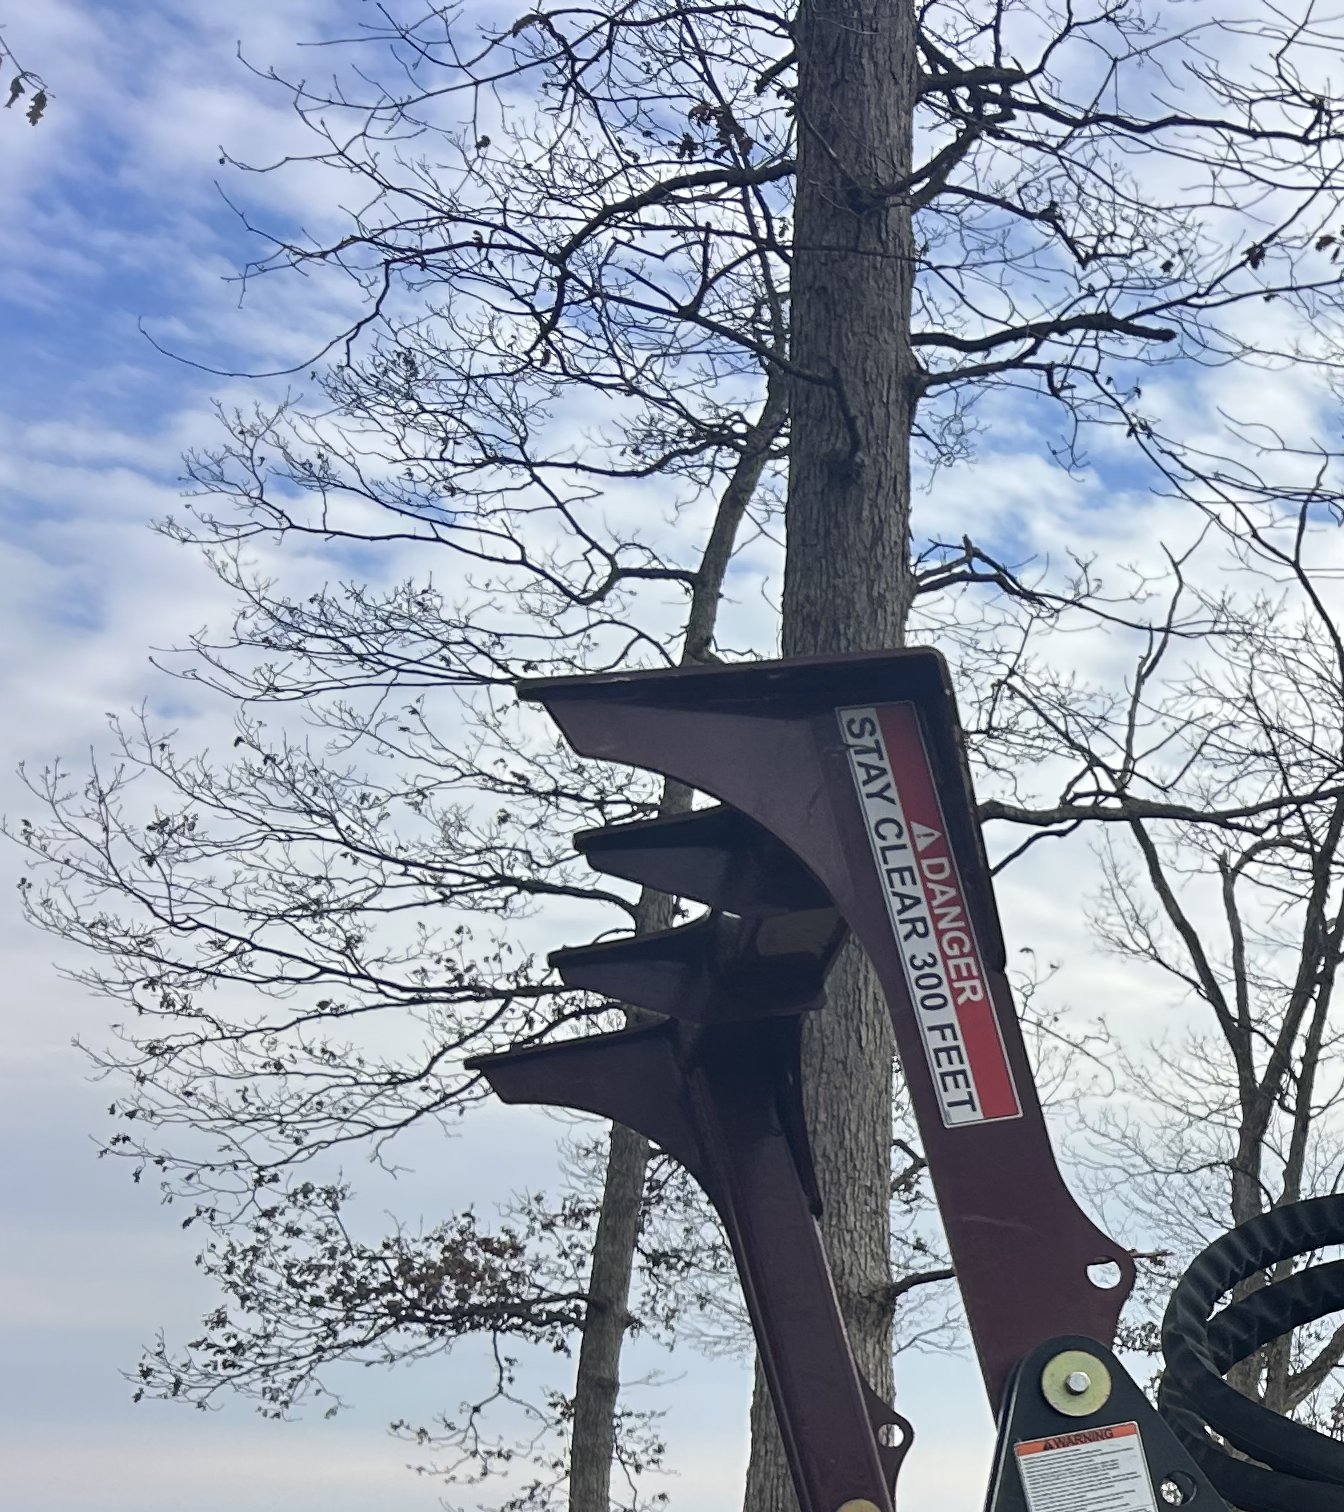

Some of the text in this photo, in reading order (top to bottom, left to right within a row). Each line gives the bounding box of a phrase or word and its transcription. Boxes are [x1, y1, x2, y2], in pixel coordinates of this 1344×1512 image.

[846, 716, 977, 1112] STAY CLEAR 300 FEET
[920, 856, 984, 1006] DANGER
[1054, 1428, 1114, 1450] WARNING
